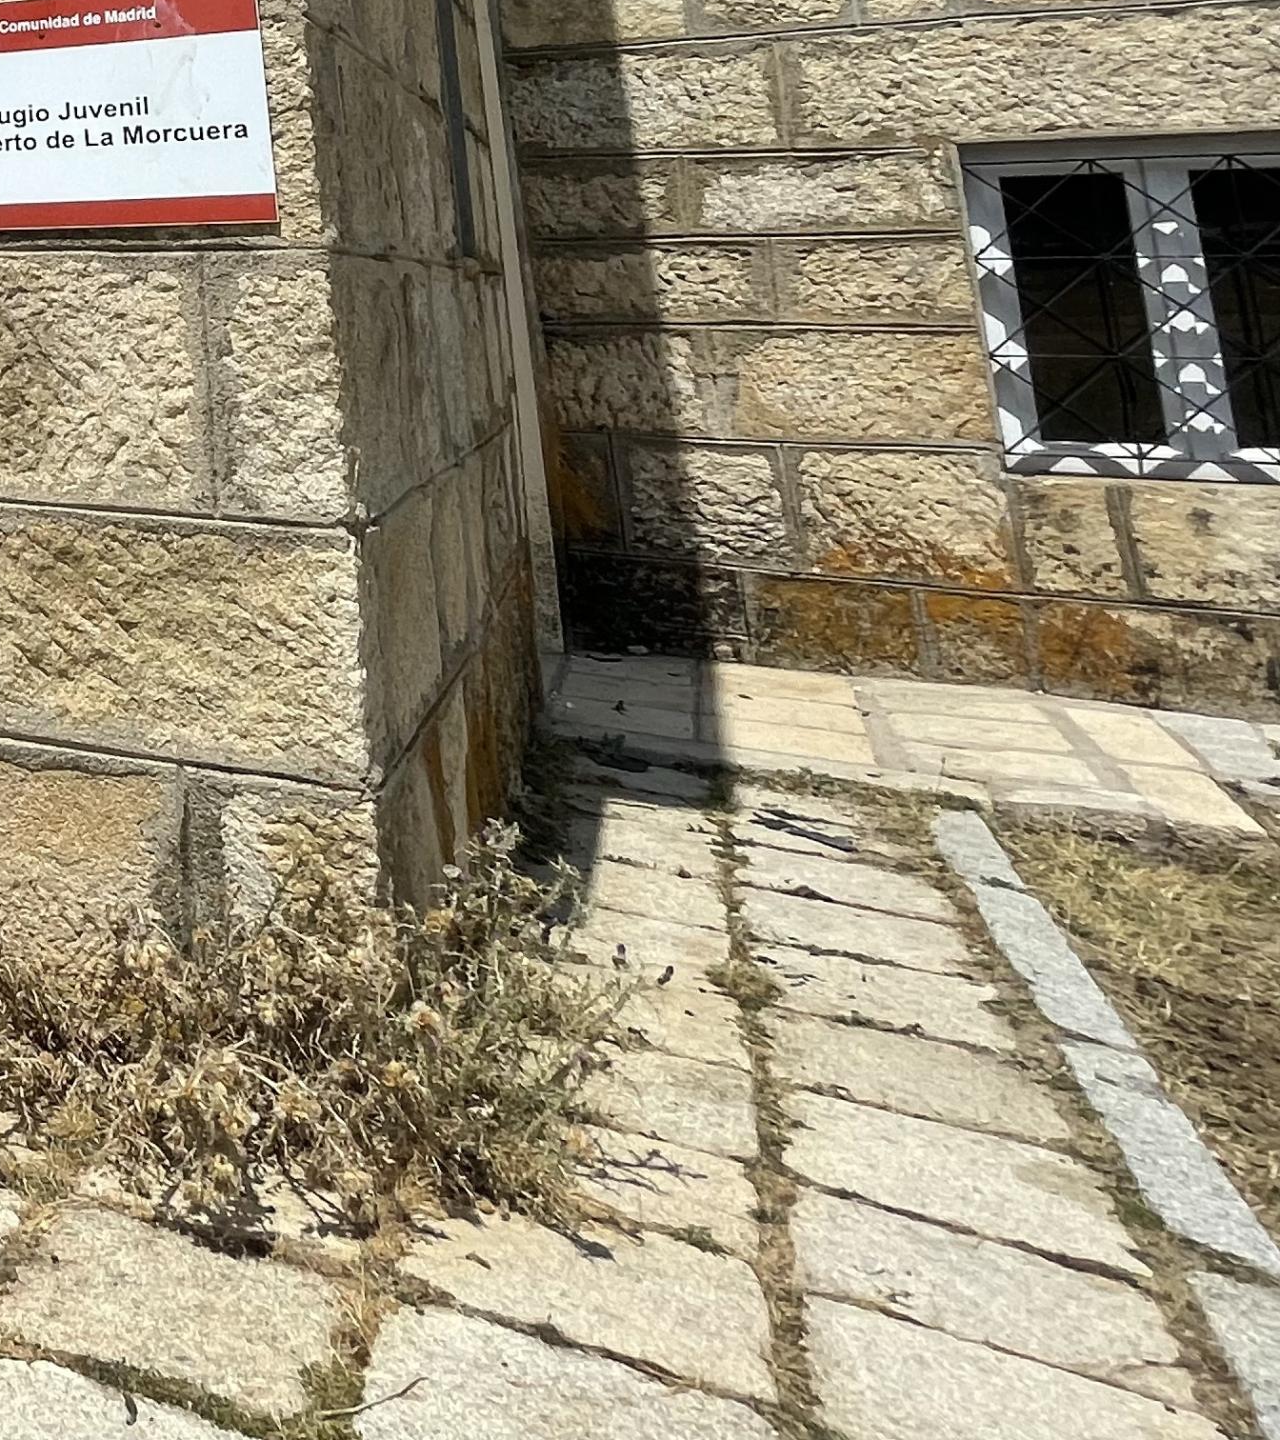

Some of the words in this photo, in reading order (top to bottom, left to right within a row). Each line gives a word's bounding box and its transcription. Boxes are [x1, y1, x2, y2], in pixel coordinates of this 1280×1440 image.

[83, 11, 101, 26] de
[104, 6, 157, 24] Madrid
[58, 96, 149, 120] Juvenil
[46, 130, 75, 149] de
[84, 128, 114, 147] La
[122, 123, 249, 145] Morcuera
